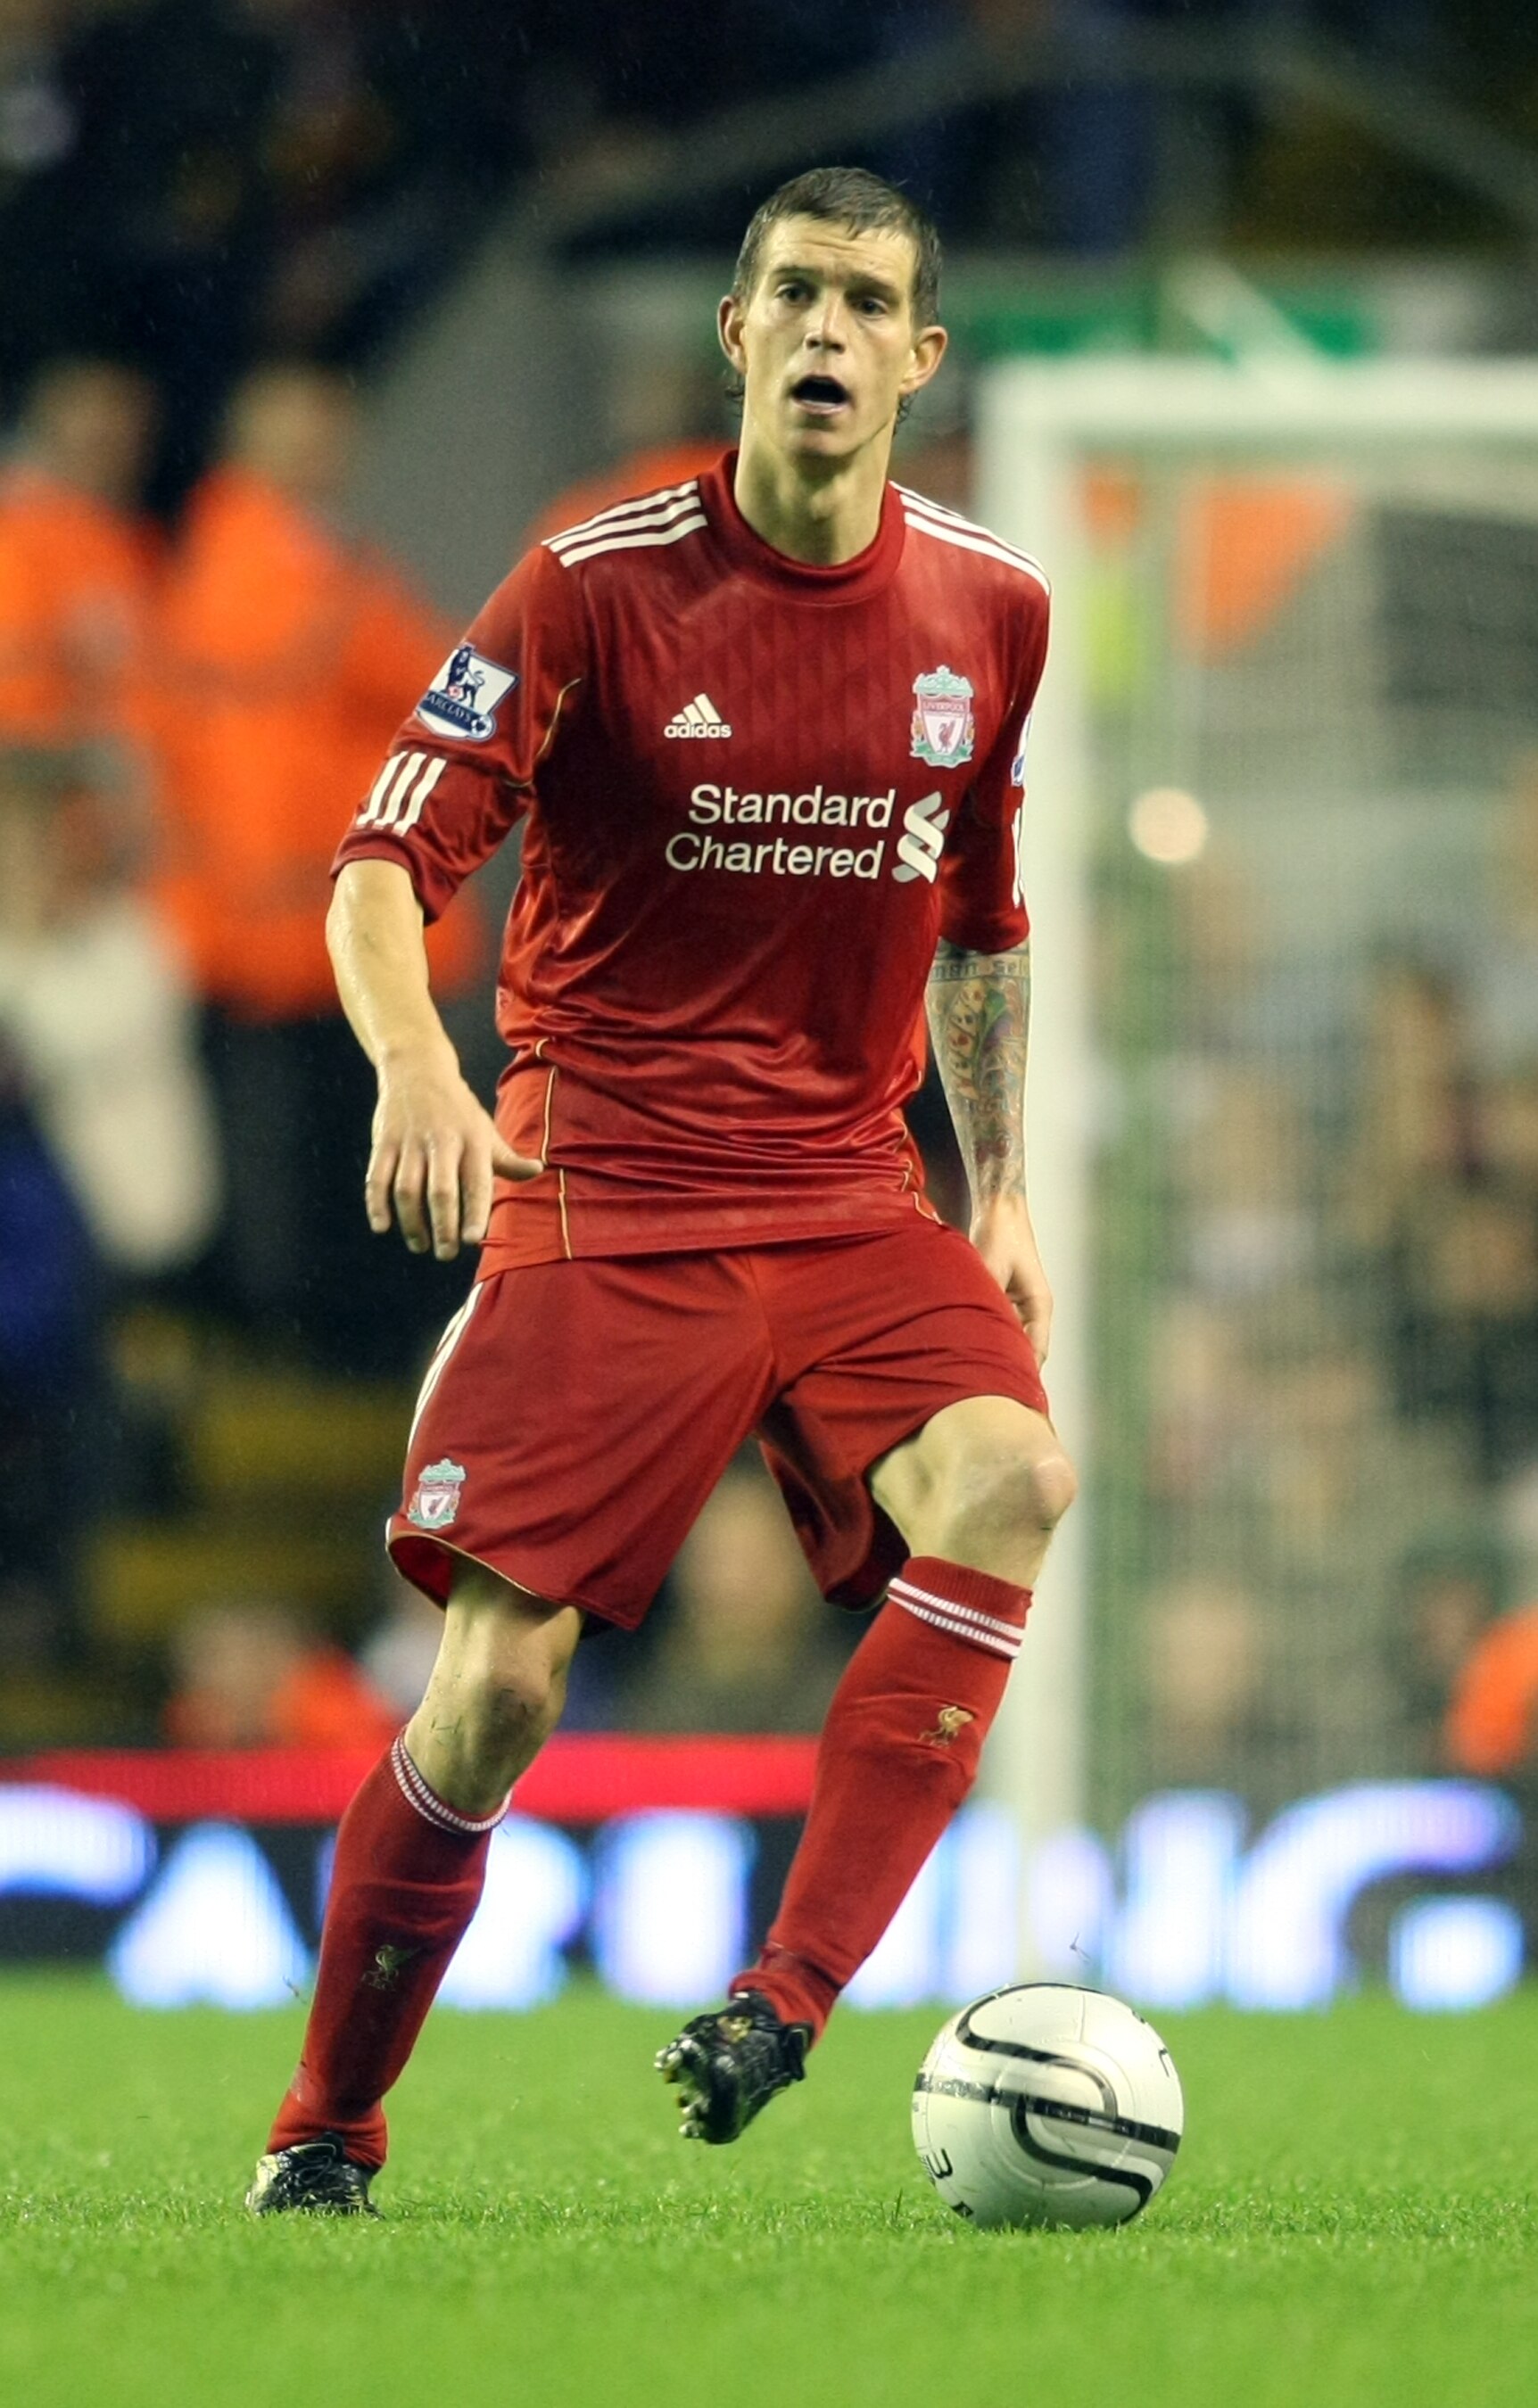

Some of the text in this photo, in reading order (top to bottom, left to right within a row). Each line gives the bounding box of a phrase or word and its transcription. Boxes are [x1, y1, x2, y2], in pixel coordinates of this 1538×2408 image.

[428, 693, 472, 722] ARCLAYS
[664, 722, 732, 739] adidas
[688, 783, 896, 829] Standard
[665, 831, 885, 879] Chartered
